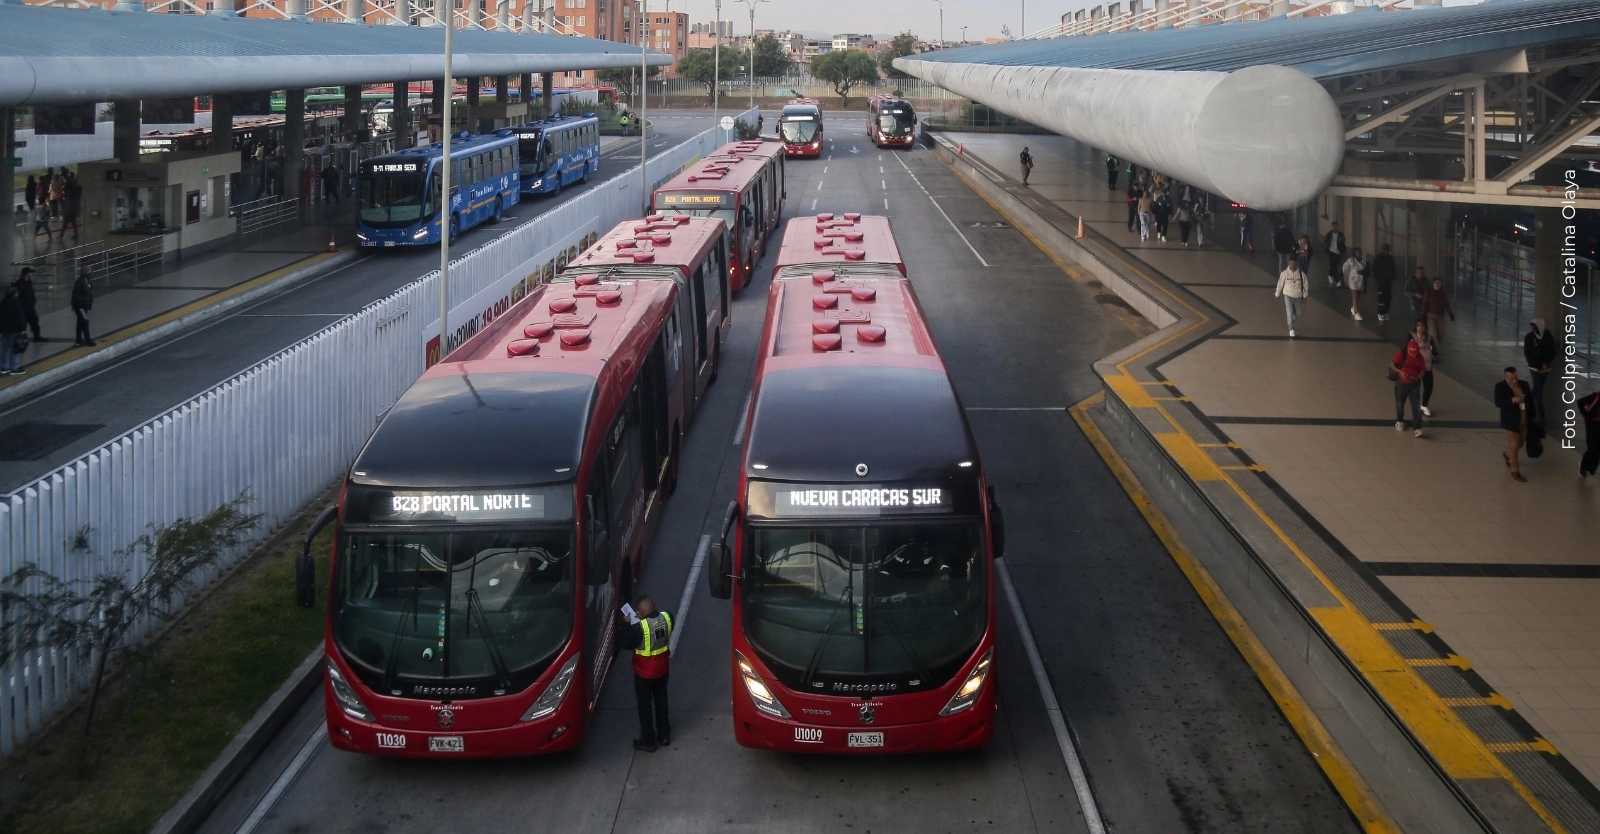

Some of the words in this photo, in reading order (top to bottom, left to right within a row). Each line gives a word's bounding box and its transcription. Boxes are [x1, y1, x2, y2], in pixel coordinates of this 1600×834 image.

[404, 163, 417, 171] SECA
[392, 496, 420, 512] B28
[423, 495, 479, 512] PORTAL
[483, 494, 531, 510] NORTE
[790, 490, 838, 506] NUEVA
[842, 489, 908, 506] CARACAS
[912, 488, 941, 505] SUR
[413, 685, 476, 696] Marcopolo
[832, 682, 897, 693] Marcopolo
[802, 708, 831, 716] VOLVO
[376, 733, 406, 746] T1030
[794, 727, 823, 741] U1009
